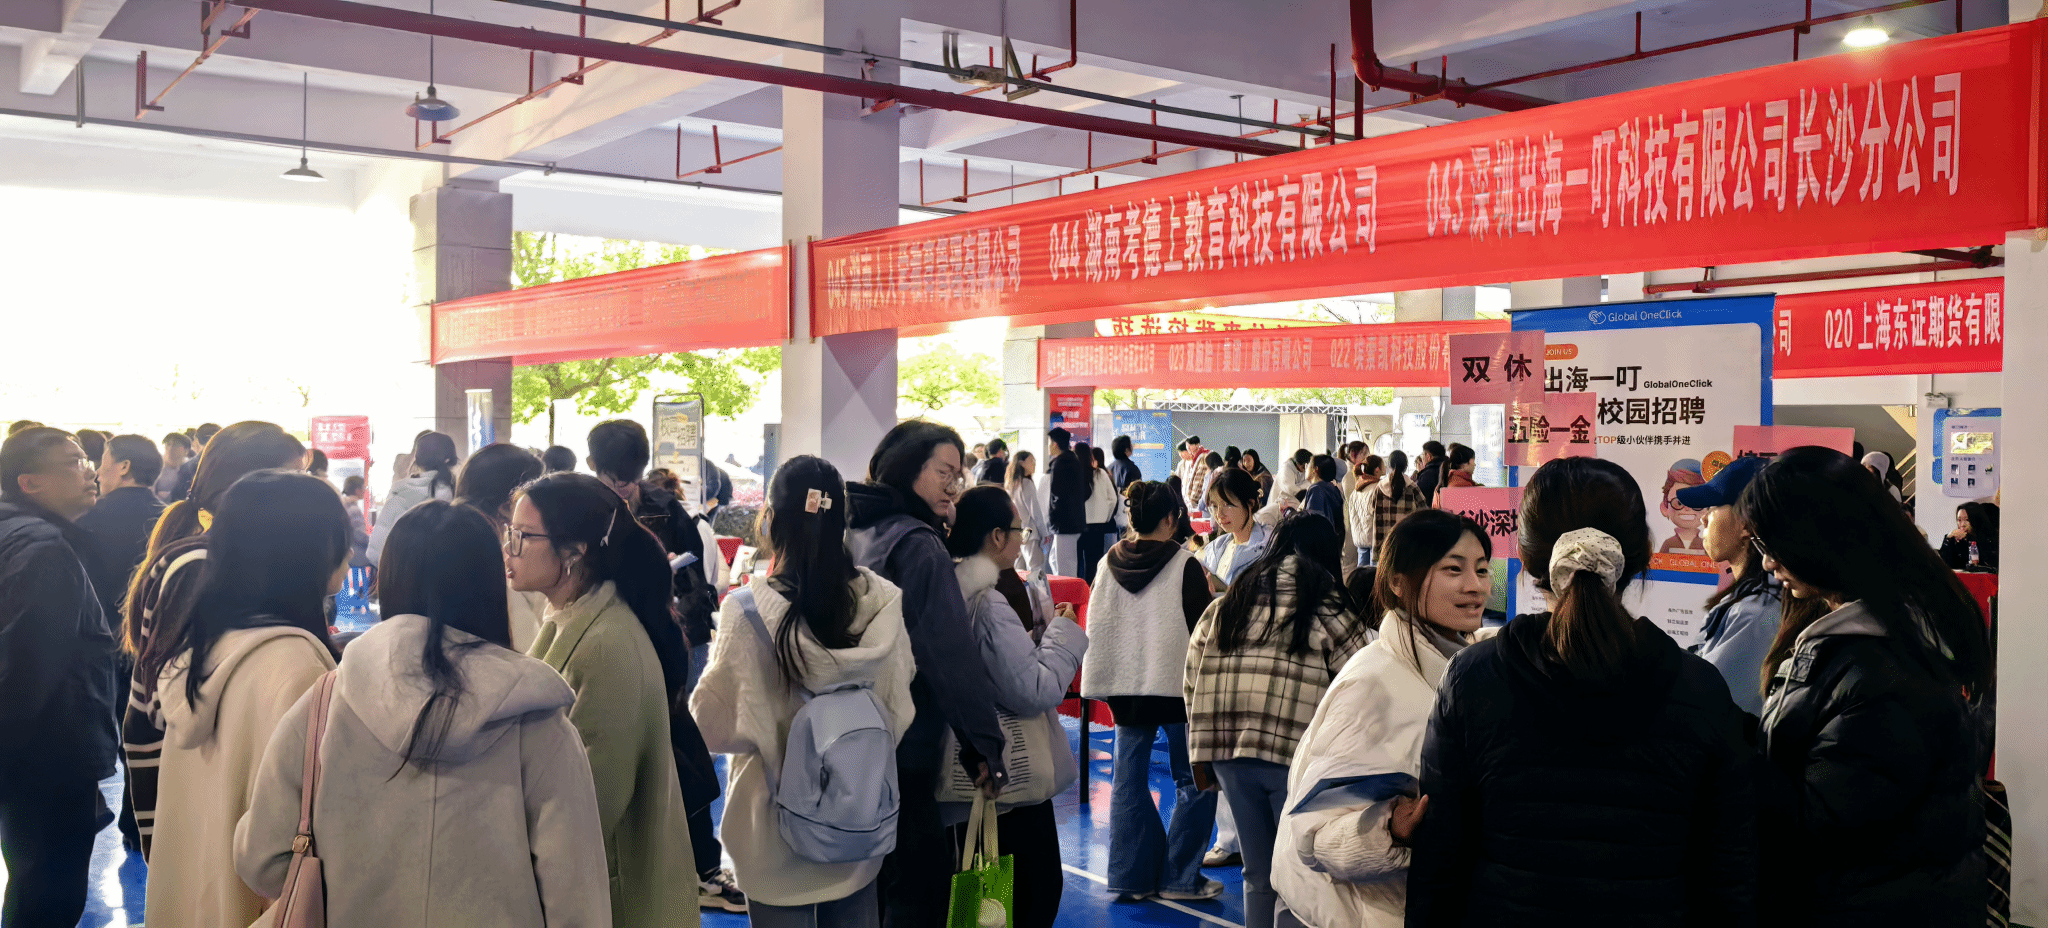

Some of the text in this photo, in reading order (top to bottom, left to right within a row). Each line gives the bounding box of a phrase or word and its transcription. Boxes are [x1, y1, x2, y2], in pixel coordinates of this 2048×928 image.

[1608, 309, 1683, 322] Global OneClick
[1824, 307, 1853, 350] 020
[1643, 379, 1713, 389] GlobalOneClick
[1597, 396, 1706, 425] 校园招聘
[1507, 414, 1591, 444] 五险一金
